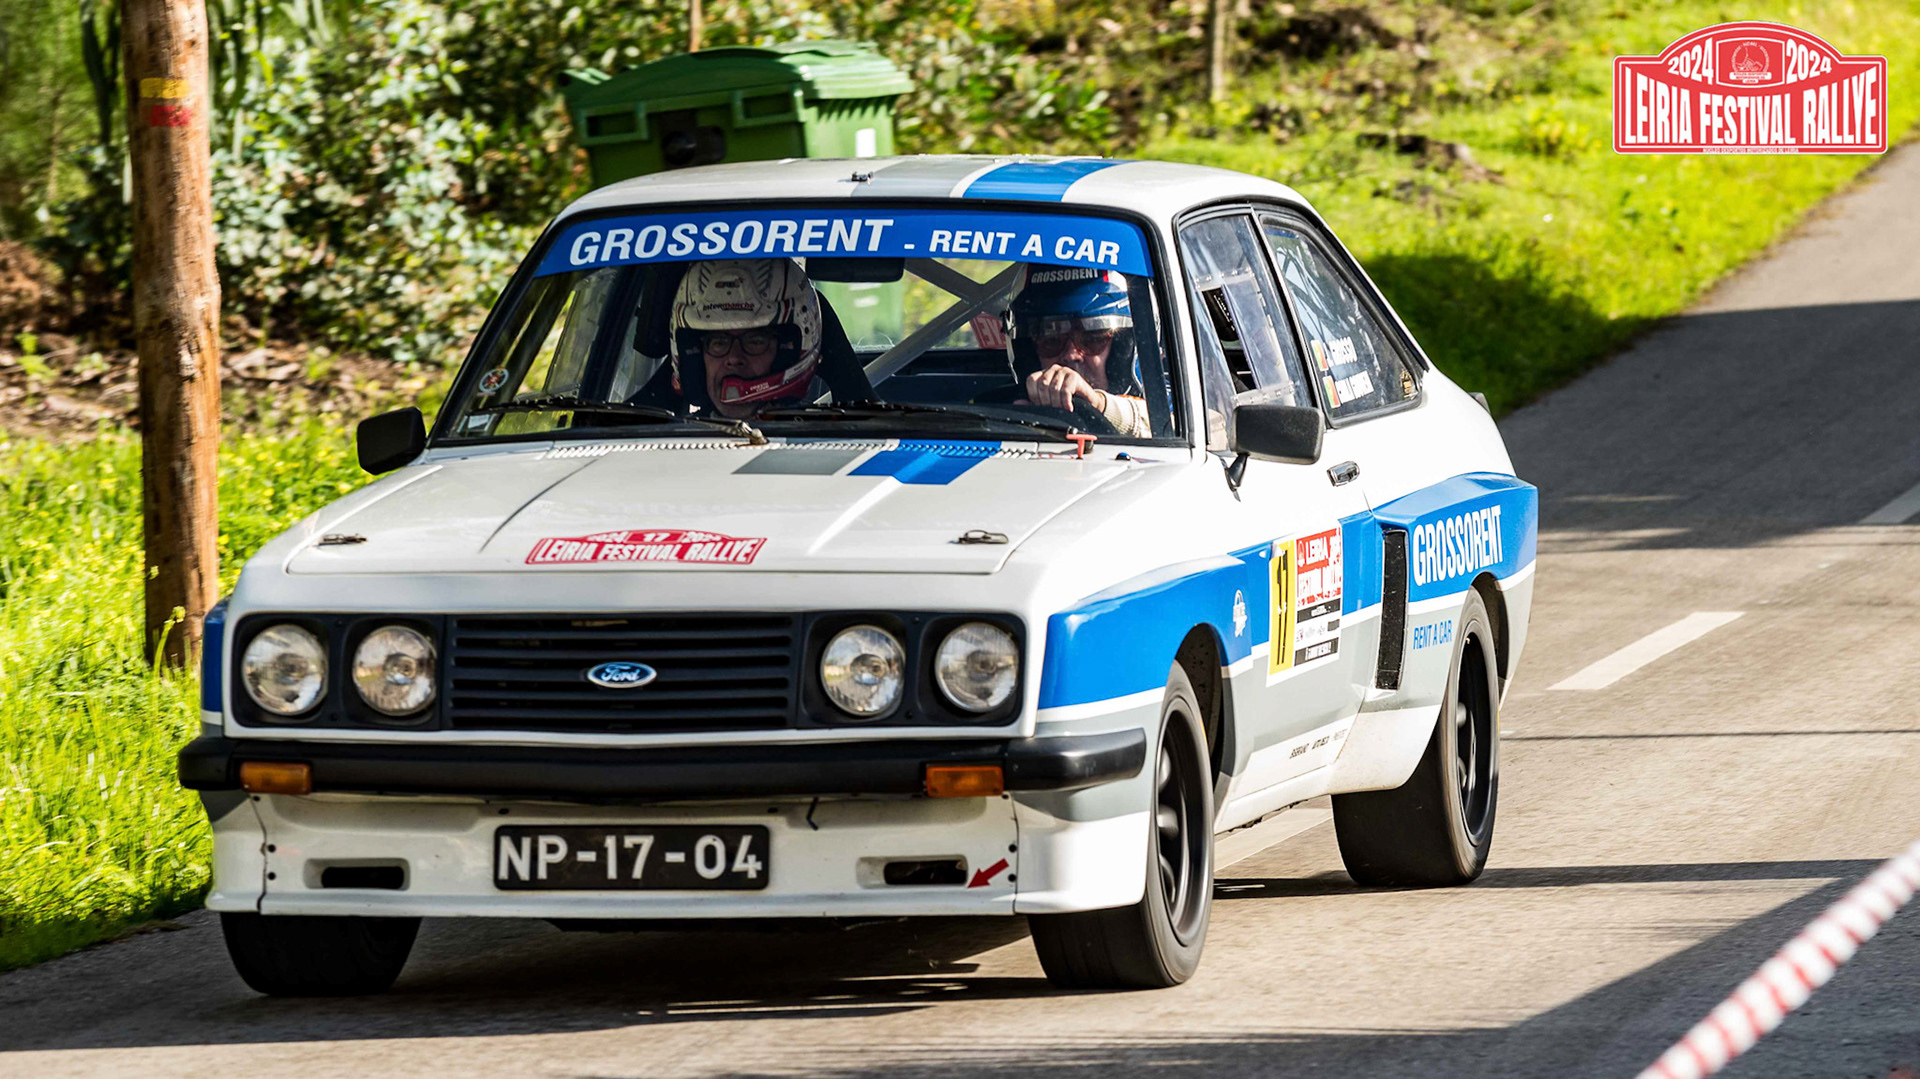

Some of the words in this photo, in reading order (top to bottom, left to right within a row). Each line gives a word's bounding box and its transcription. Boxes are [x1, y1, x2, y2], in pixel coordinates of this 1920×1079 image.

[569, 218, 894, 266] GROSSORENT
[929, 230, 1015, 255] RENT
[1021, 236, 1044, 257] A
[1055, 238, 1120, 266] CAR
[1031, 268, 1099, 284] GROSSORENT
[535, 539, 599, 562] LEIRIA
[597, 543, 680, 561] FESTIVAL
[684, 538, 759, 562] RALLYE
[643, 532, 670, 542] 17
[1412, 504, 1503, 586] GROSSORENT
[1413, 624, 1432, 650] RENT
[1432, 622, 1438, 646] A
[1439, 620, 1453, 644] CAR
[600, 663, 641, 682] Ford
[498, 834, 763, 881] NP-17-04
